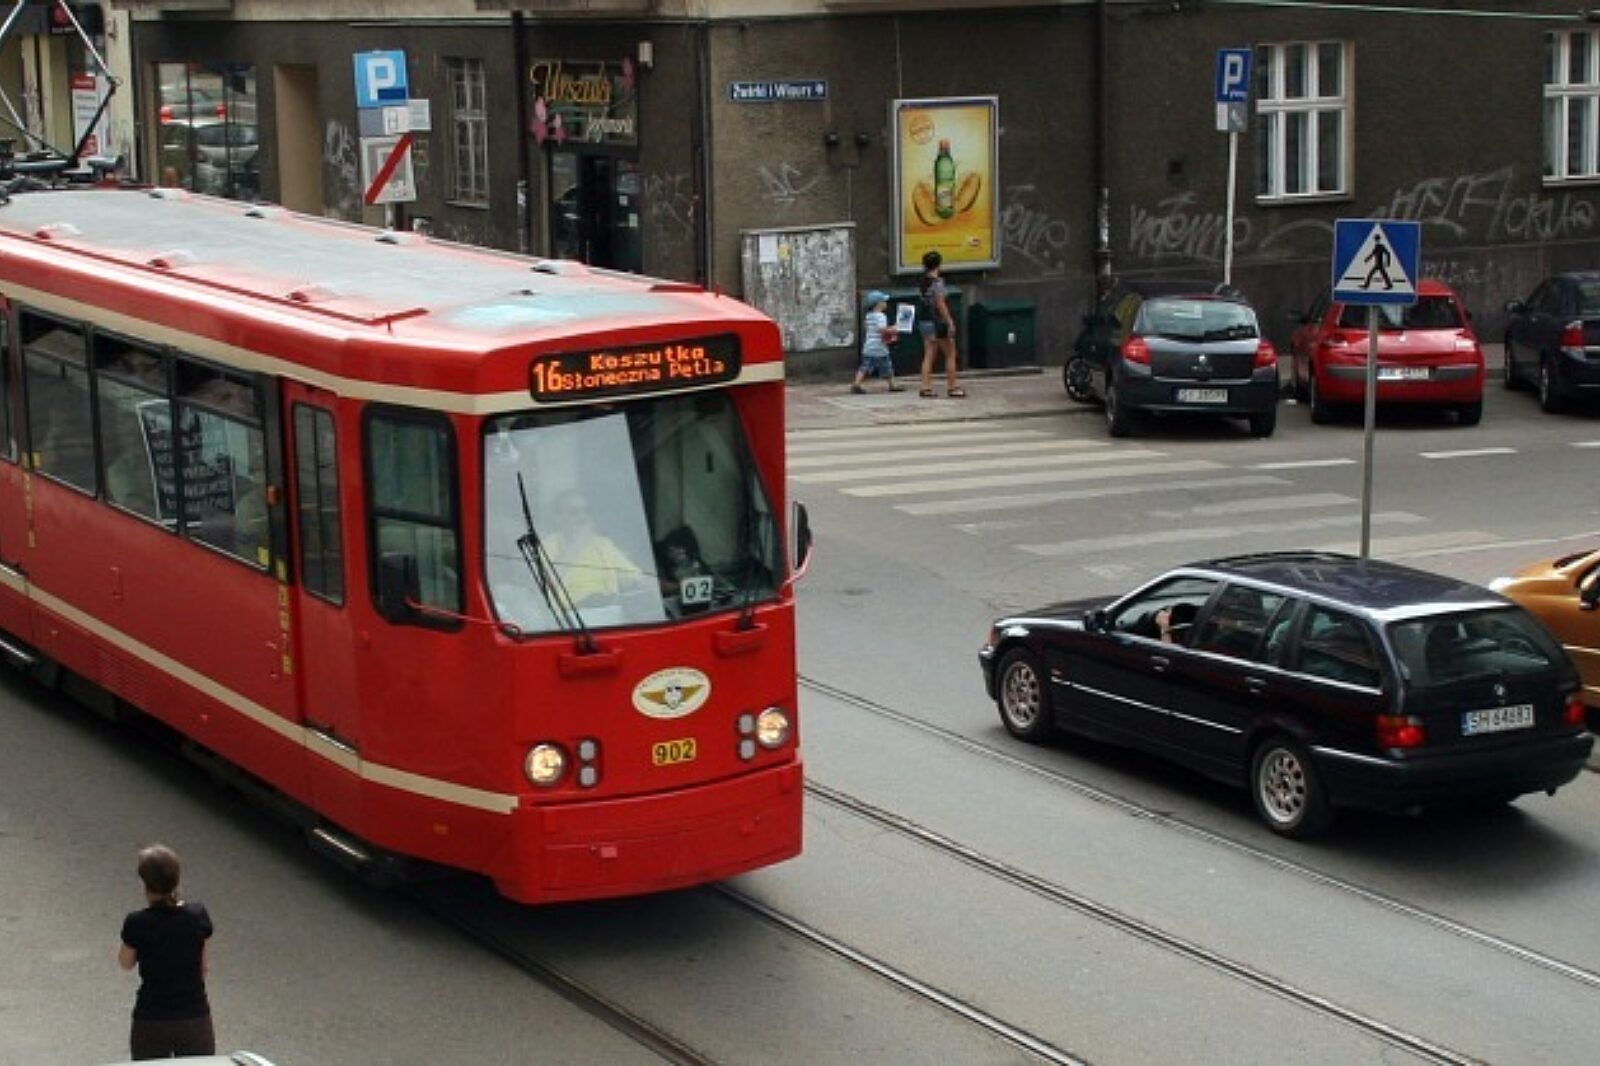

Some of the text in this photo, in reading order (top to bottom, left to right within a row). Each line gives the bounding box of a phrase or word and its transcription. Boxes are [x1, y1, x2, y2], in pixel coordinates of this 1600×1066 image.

[367, 57, 396, 101] P
[1222, 54, 1244, 95] P
[590, 346, 705, 370] Koszutka
[533, 361, 563, 393] 16
[685, 580, 710, 599] 02
[655, 740, 694, 764] 902
